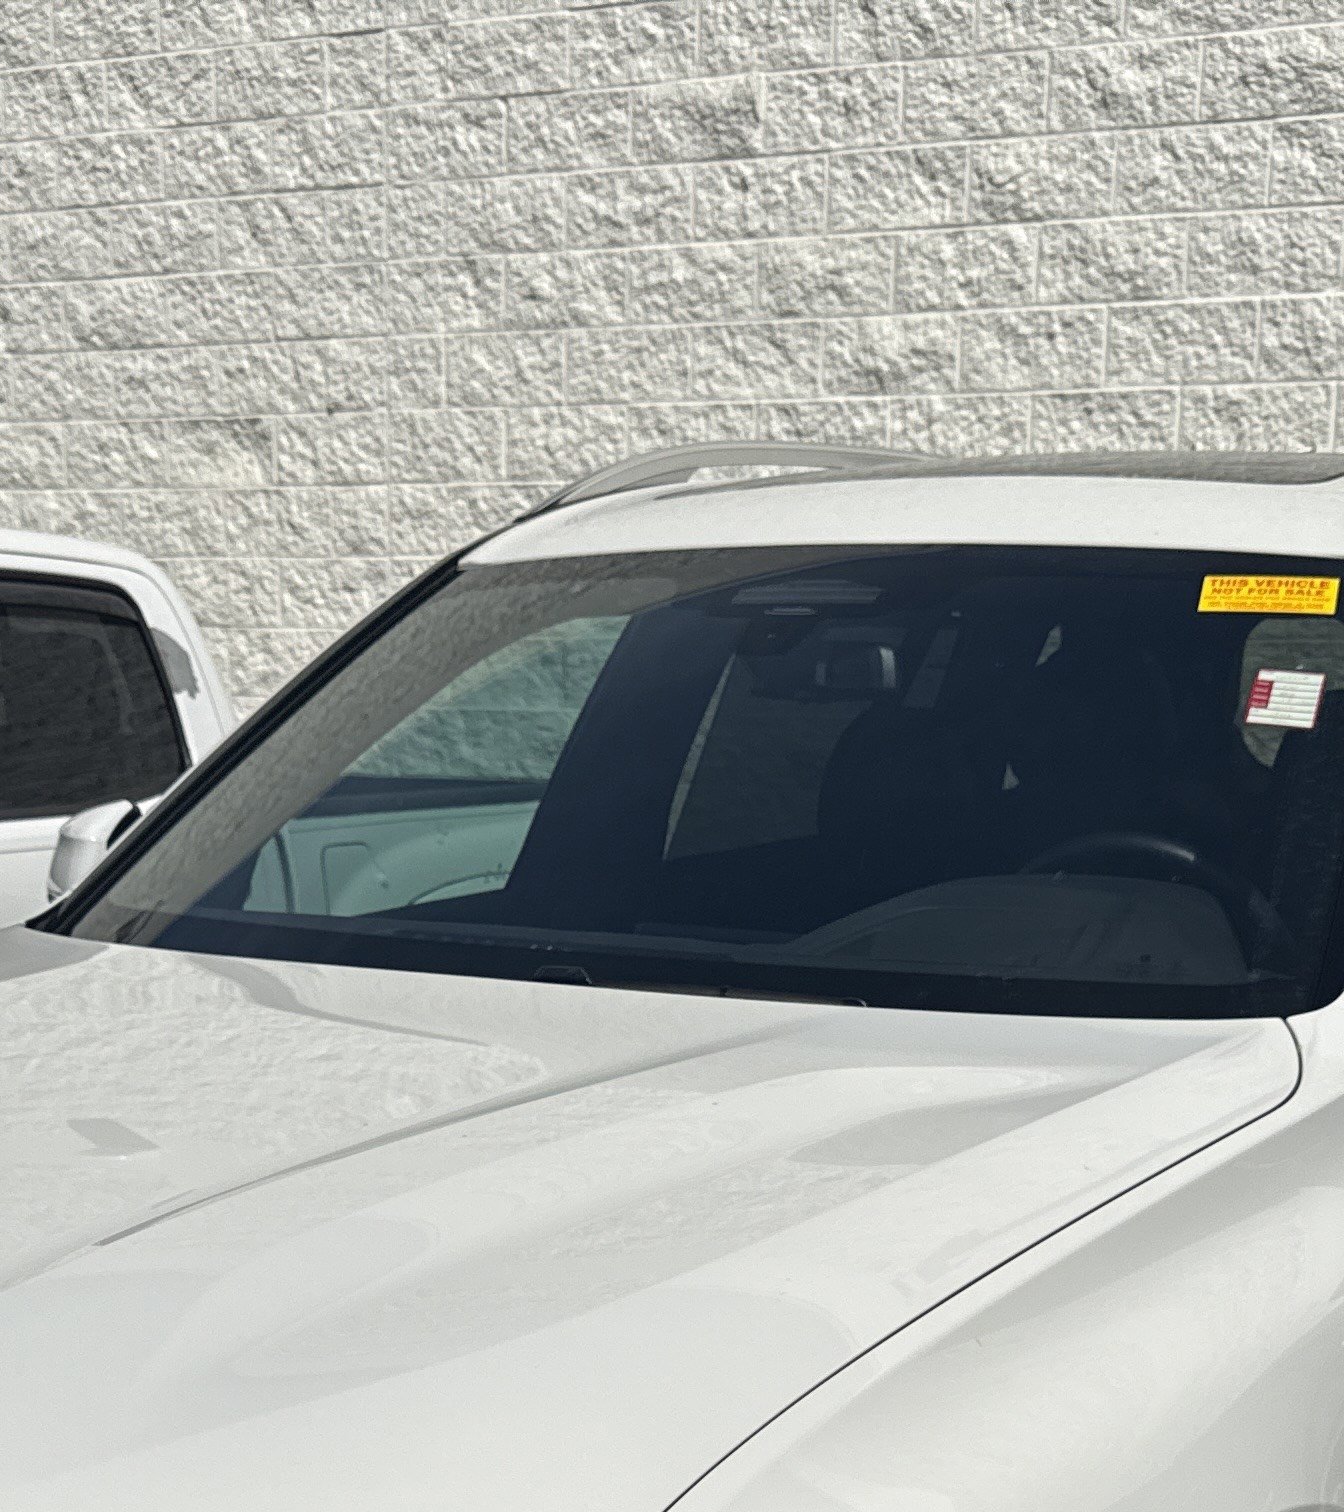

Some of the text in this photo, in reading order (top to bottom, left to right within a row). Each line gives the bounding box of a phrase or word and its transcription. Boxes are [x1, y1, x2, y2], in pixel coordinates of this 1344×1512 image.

[1210, 579, 1331, 590] THIS VEHICLE
[1211, 587, 1326, 597] NOT FOR SALE
